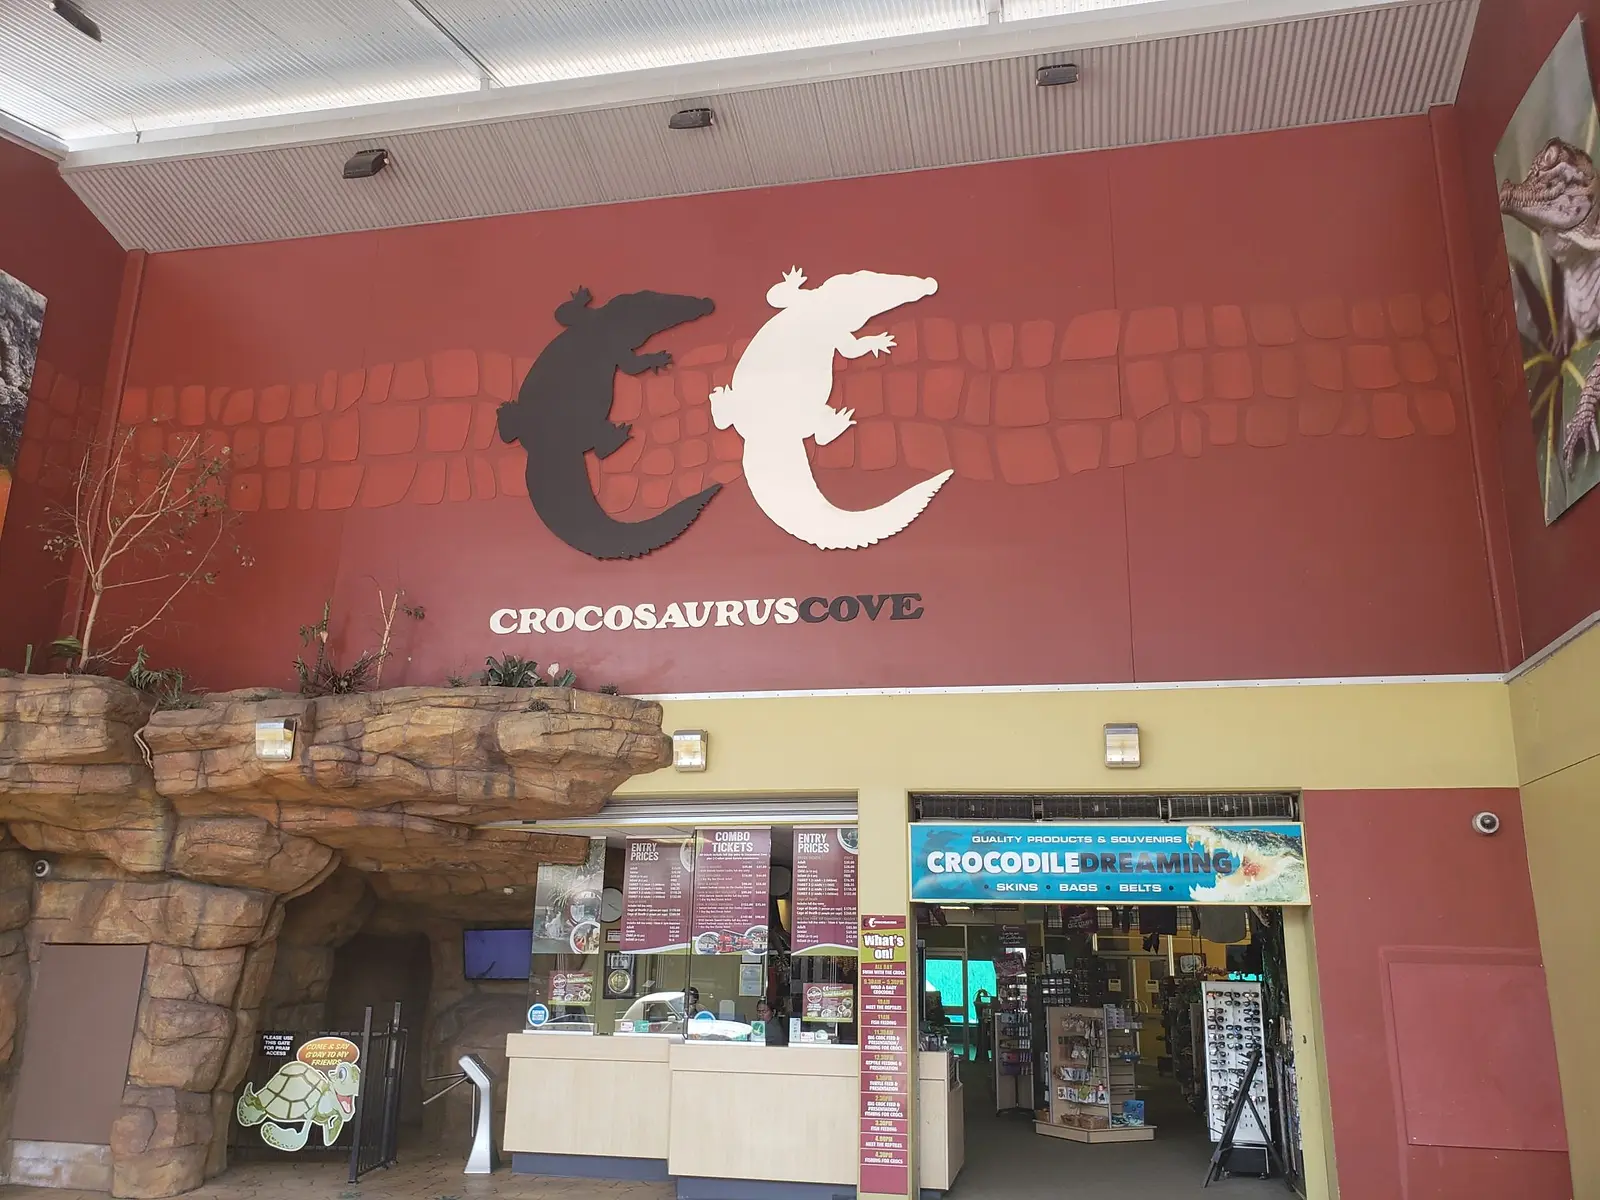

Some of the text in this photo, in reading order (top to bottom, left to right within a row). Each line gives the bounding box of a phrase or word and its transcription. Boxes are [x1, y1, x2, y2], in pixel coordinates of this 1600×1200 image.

[715, 831, 751, 842] COMBO
[798, 833, 826, 843] ENTRY
[632, 842, 658, 852] ENTRY
[712, 842, 754, 852] TICKETS
[798, 843, 830, 853] PRICES
[630, 852, 659, 860] PRICES
[996, 883, 1162, 892] SKINS BAGS BELTS
[863, 934, 905, 947] What's
[874, 948, 894, 960] on!
